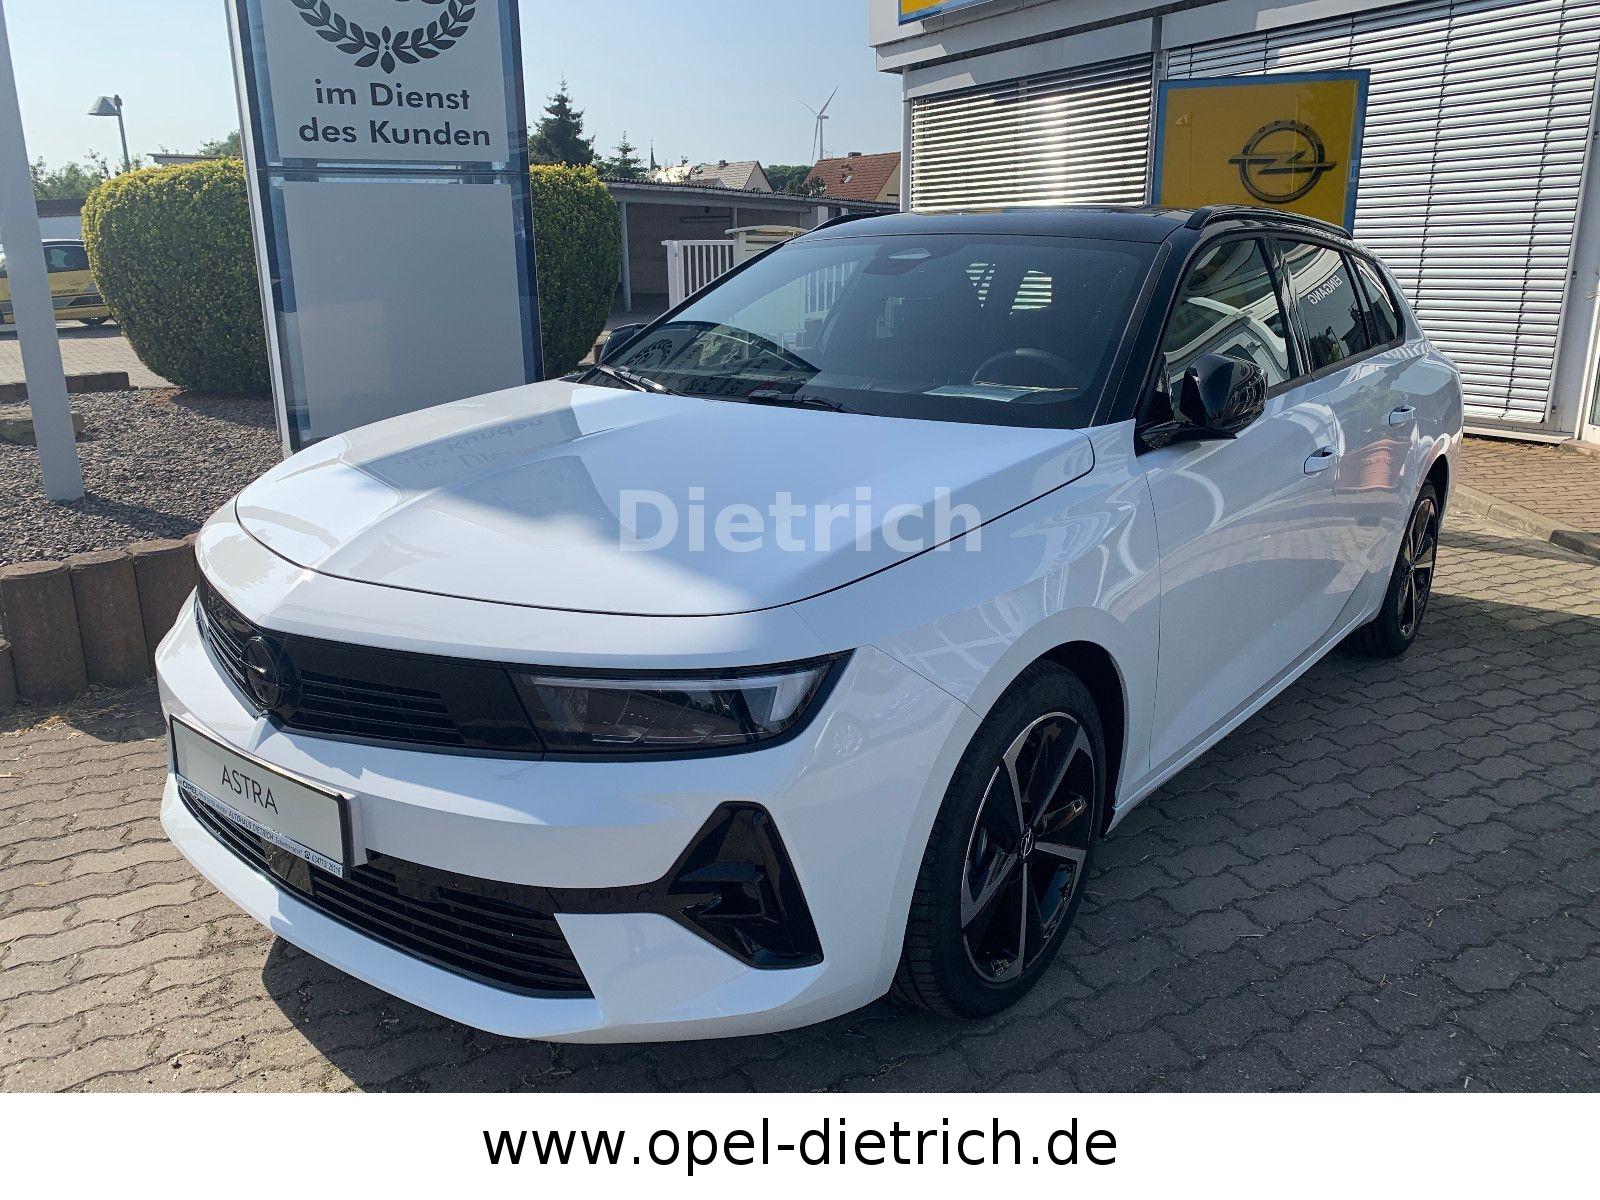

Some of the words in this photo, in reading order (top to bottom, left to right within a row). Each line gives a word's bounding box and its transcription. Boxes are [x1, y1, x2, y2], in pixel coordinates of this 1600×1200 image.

[314, 78, 357, 105] im
[369, 82, 470, 110] Dienst
[299, 117, 358, 143] des
[369, 120, 490, 146] Kunden
[221, 764, 279, 815] ASTRA
